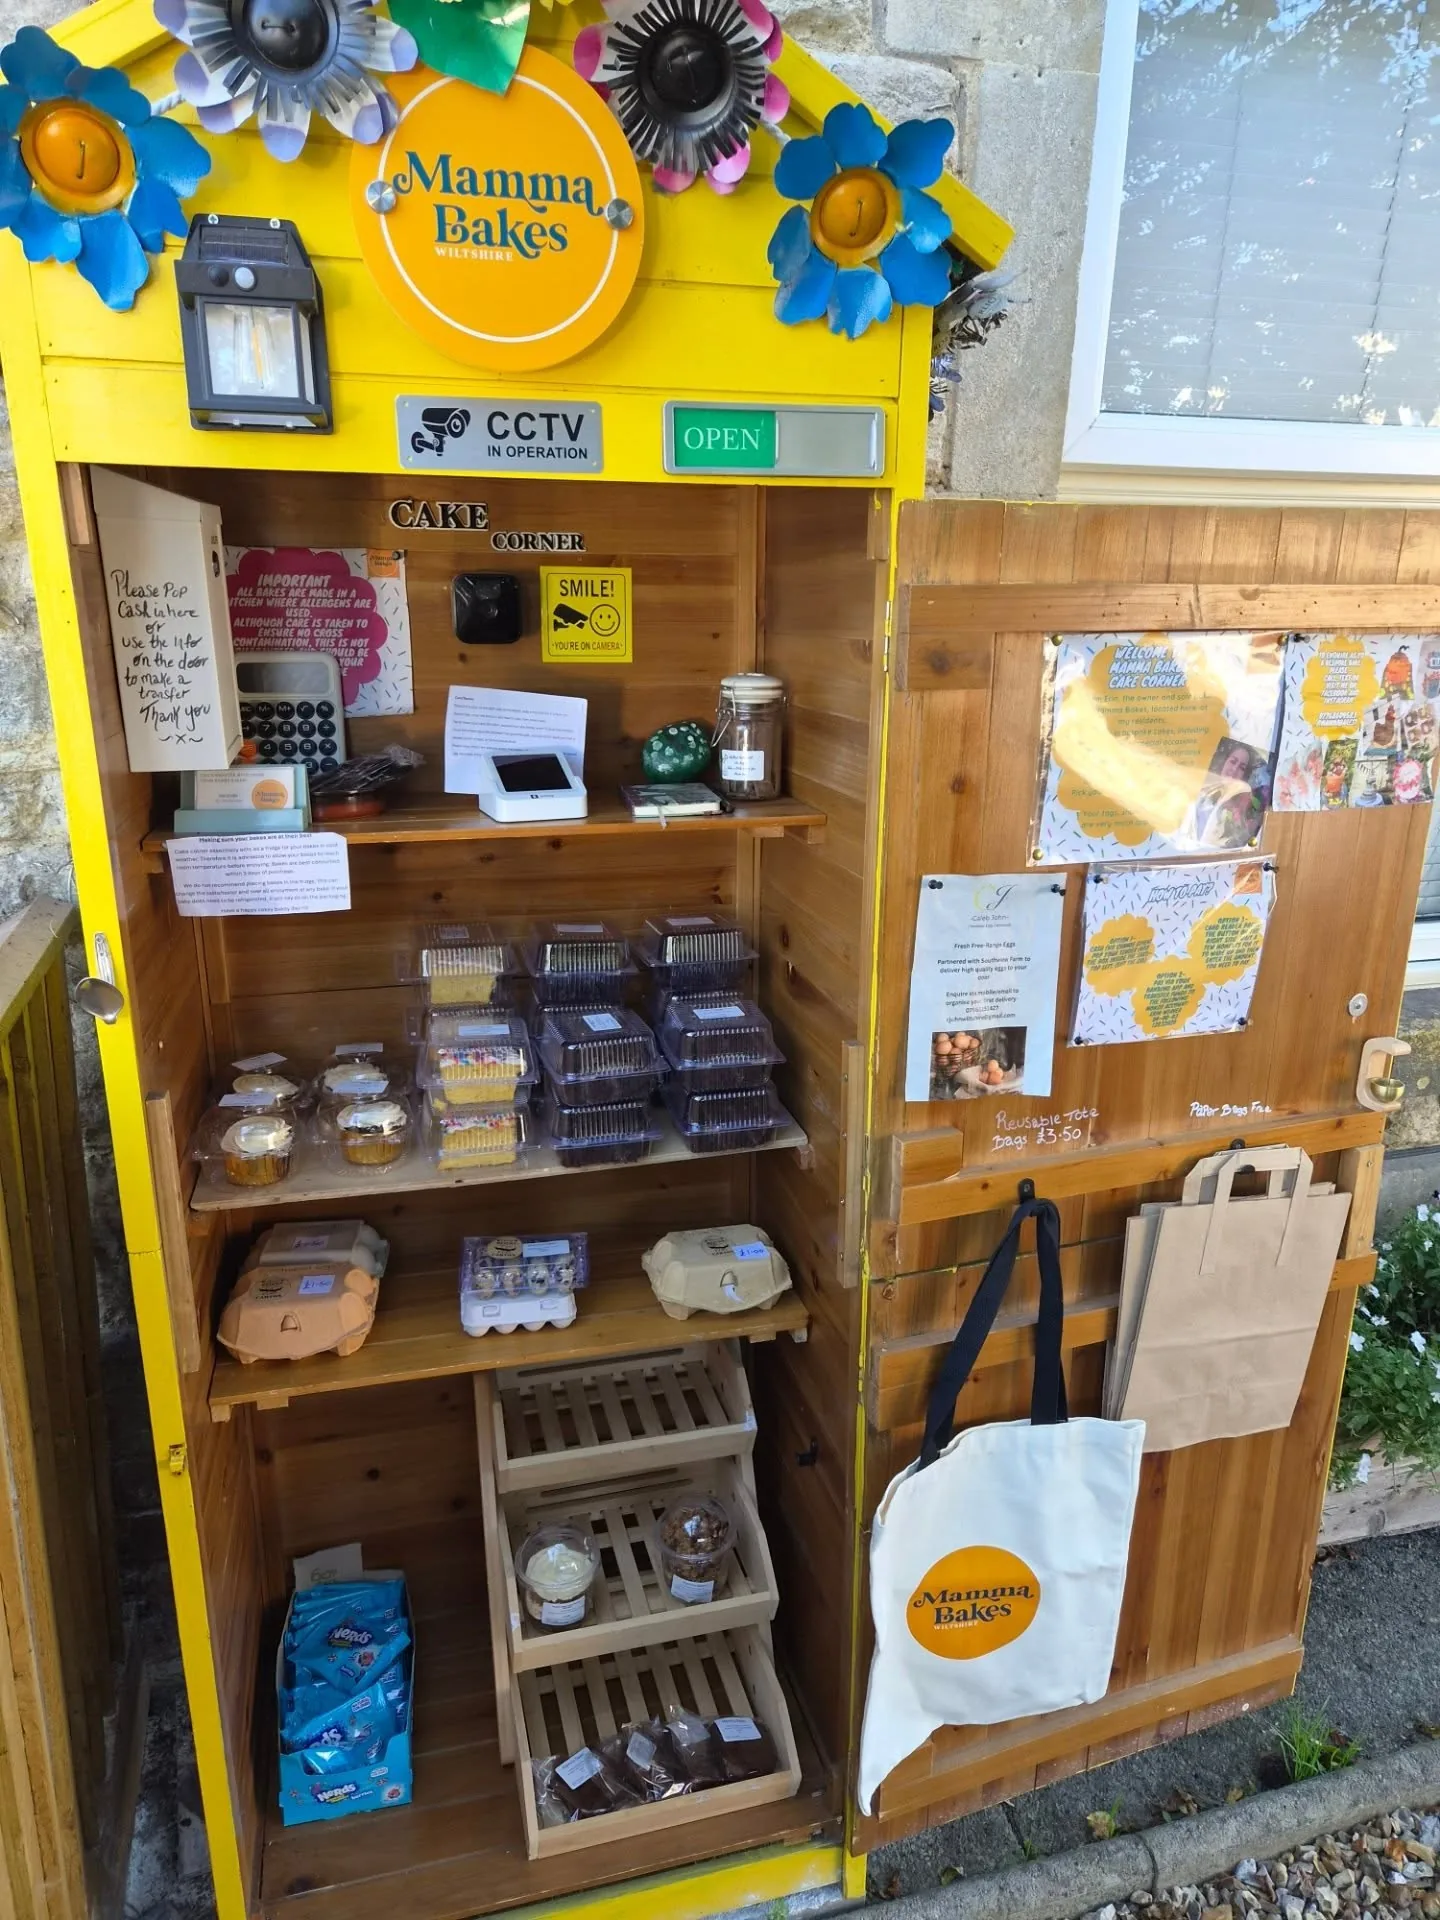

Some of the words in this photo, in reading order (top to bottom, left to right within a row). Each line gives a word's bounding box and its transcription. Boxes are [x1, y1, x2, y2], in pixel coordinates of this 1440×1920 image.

[392, 150, 605, 216] Mamma
[433, 203, 568, 259] Bakes
[434, 246, 514, 262] WILTSHIRE
[486, 411, 584, 441] CCTV
[684, 426, 761, 451] OPEN
[487, 445, 502, 458] IN
[506, 445, 588, 460] OPERATION
[388, 499, 490, 532] CAKE
[491, 531, 586, 552] CORNER
[110, 569, 159, 599] Please
[163, 581, 188, 598] Pop
[257, 574, 331, 588] IMPORTANT
[559, 579, 615, 598] SMILE!
[236, 587, 254, 598] ALL
[256, 588, 286, 598] BAKES
[289, 588, 307, 598] ARE
[309, 588, 335, 599] MADE
[337, 588, 348, 599] IN
[350, 589, 357, 599] A
[117, 600, 150, 619] Cash
[153, 605, 165, 618] in
[167, 603, 199, 618] here
[229, 597, 264, 608] ITCHEN
[267, 597, 297, 608] WHERE
[300, 598, 351, 609] ALLERGENS
[354, 598, 373, 609] ARE
[285, 607, 313, 618] USED.
[145, 622, 166, 635] or
[233, 616, 284, 628] ALTHOUGH
[286, 617, 310, 628] CARE
[312, 618, 322, 628] IS
[325, 618, 354, 629] TAKEN
[357, 619, 369, 629] TO
[258, 627, 295, 638] ENSURE
[297, 628, 310, 638] NO
[313, 628, 344, 639] CROSS
[149, 633, 168, 651] the
[315, 638, 335, 648] THIS
[338, 638, 348, 648] IS
[351, 638, 370, 648] NOT
[581, 642, 591, 651] ON
[132, 651, 152, 667] on
[154, 653, 174, 669] the
[178, 652, 209, 671] door
[358, 648, 369, 658] BE
[1114, 646, 1169, 660] WELCOME
[339, 657, 364, 667] YOUR
[1108, 659, 1152, 674] MAMMA
[125, 667, 138, 687] to
[140, 672, 172, 689] make
[177, 674, 192, 685] a
[1108, 674, 1141, 689] CAKE
[1141, 674, 1187, 689] CORNER
[138, 686, 191, 703] transfer
[139, 700, 182, 732] Thank
[184, 704, 211, 732] you
[1220, 1103, 1248, 1117] Bags
[1251, 1100, 1272, 1114] Free
[995, 1109, 1062, 1132] Reusable
[1064, 1106, 1100, 1122] Tote
[992, 1132, 1027, 1151] Bags
[1036, 1127, 1082, 1145] £3.50
[913, 1585, 1035, 1608] Mamma
[934, 1603, 1012, 1626] Bakes
[933, 1620, 979, 1631] WILTSHIRE
